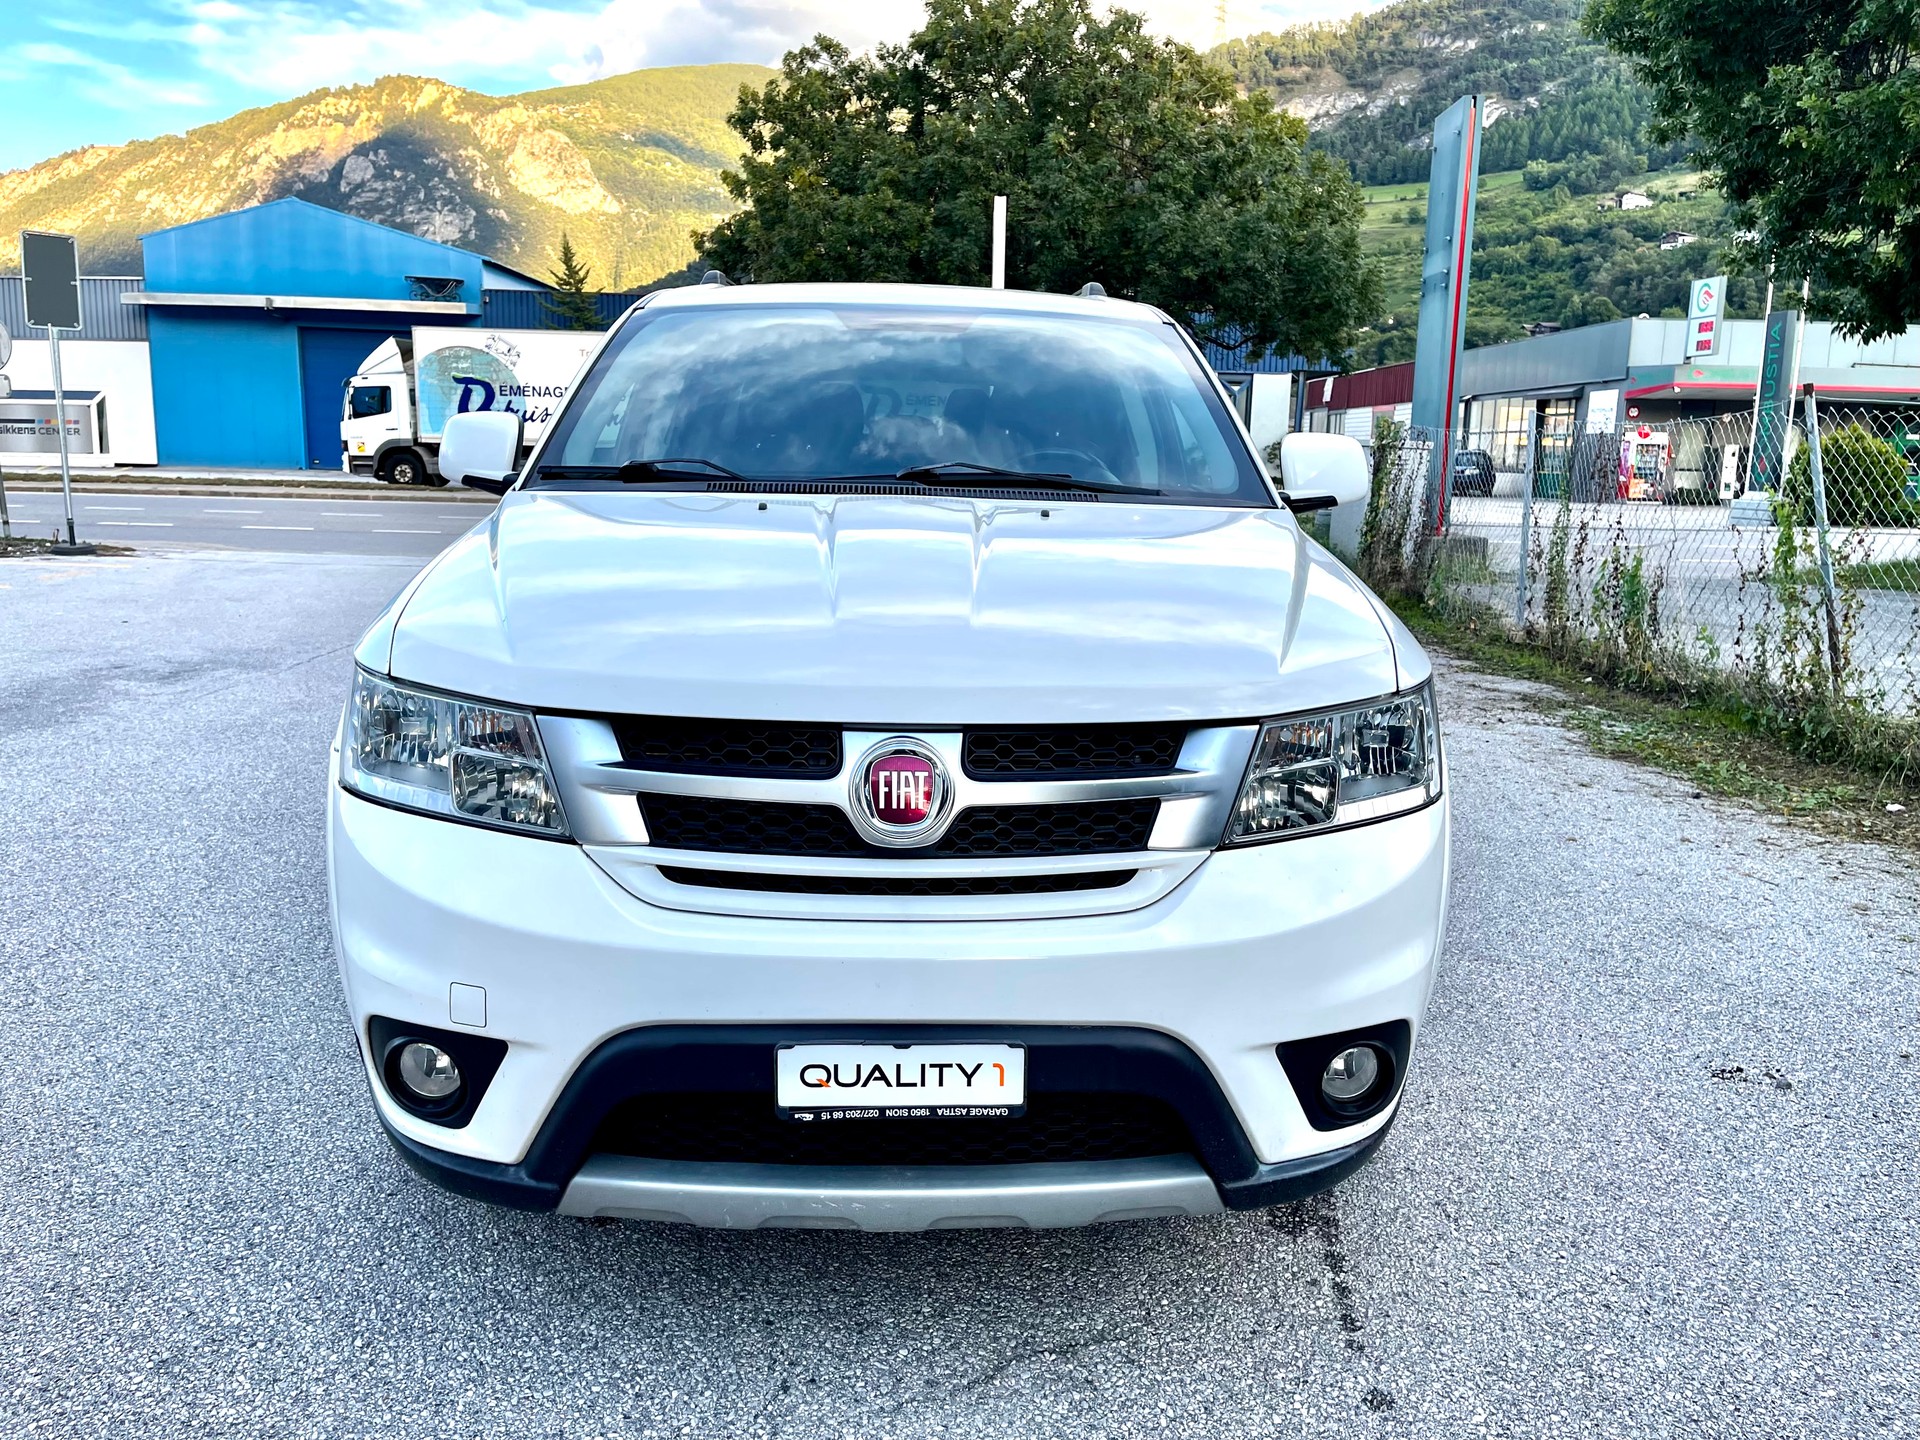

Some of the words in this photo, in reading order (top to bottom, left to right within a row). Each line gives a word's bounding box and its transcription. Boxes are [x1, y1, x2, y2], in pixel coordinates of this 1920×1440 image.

[38, 427, 80, 436] CENER
[878, 771, 929, 809] FIAT
[799, 1063, 984, 1088] QUALITY
[992, 1063, 1005, 1087] 1
[821, 1111, 831, 1120] 15
[832, 1110, 844, 1119] 68
[845, 1109, 880, 1118] 027/203
[885, 1108, 909, 1117] SION
[910, 1108, 931, 1117] 1950
[936, 1107, 968, 1116] ASTRA
[969, 1107, 1009, 1116] GARAGE
